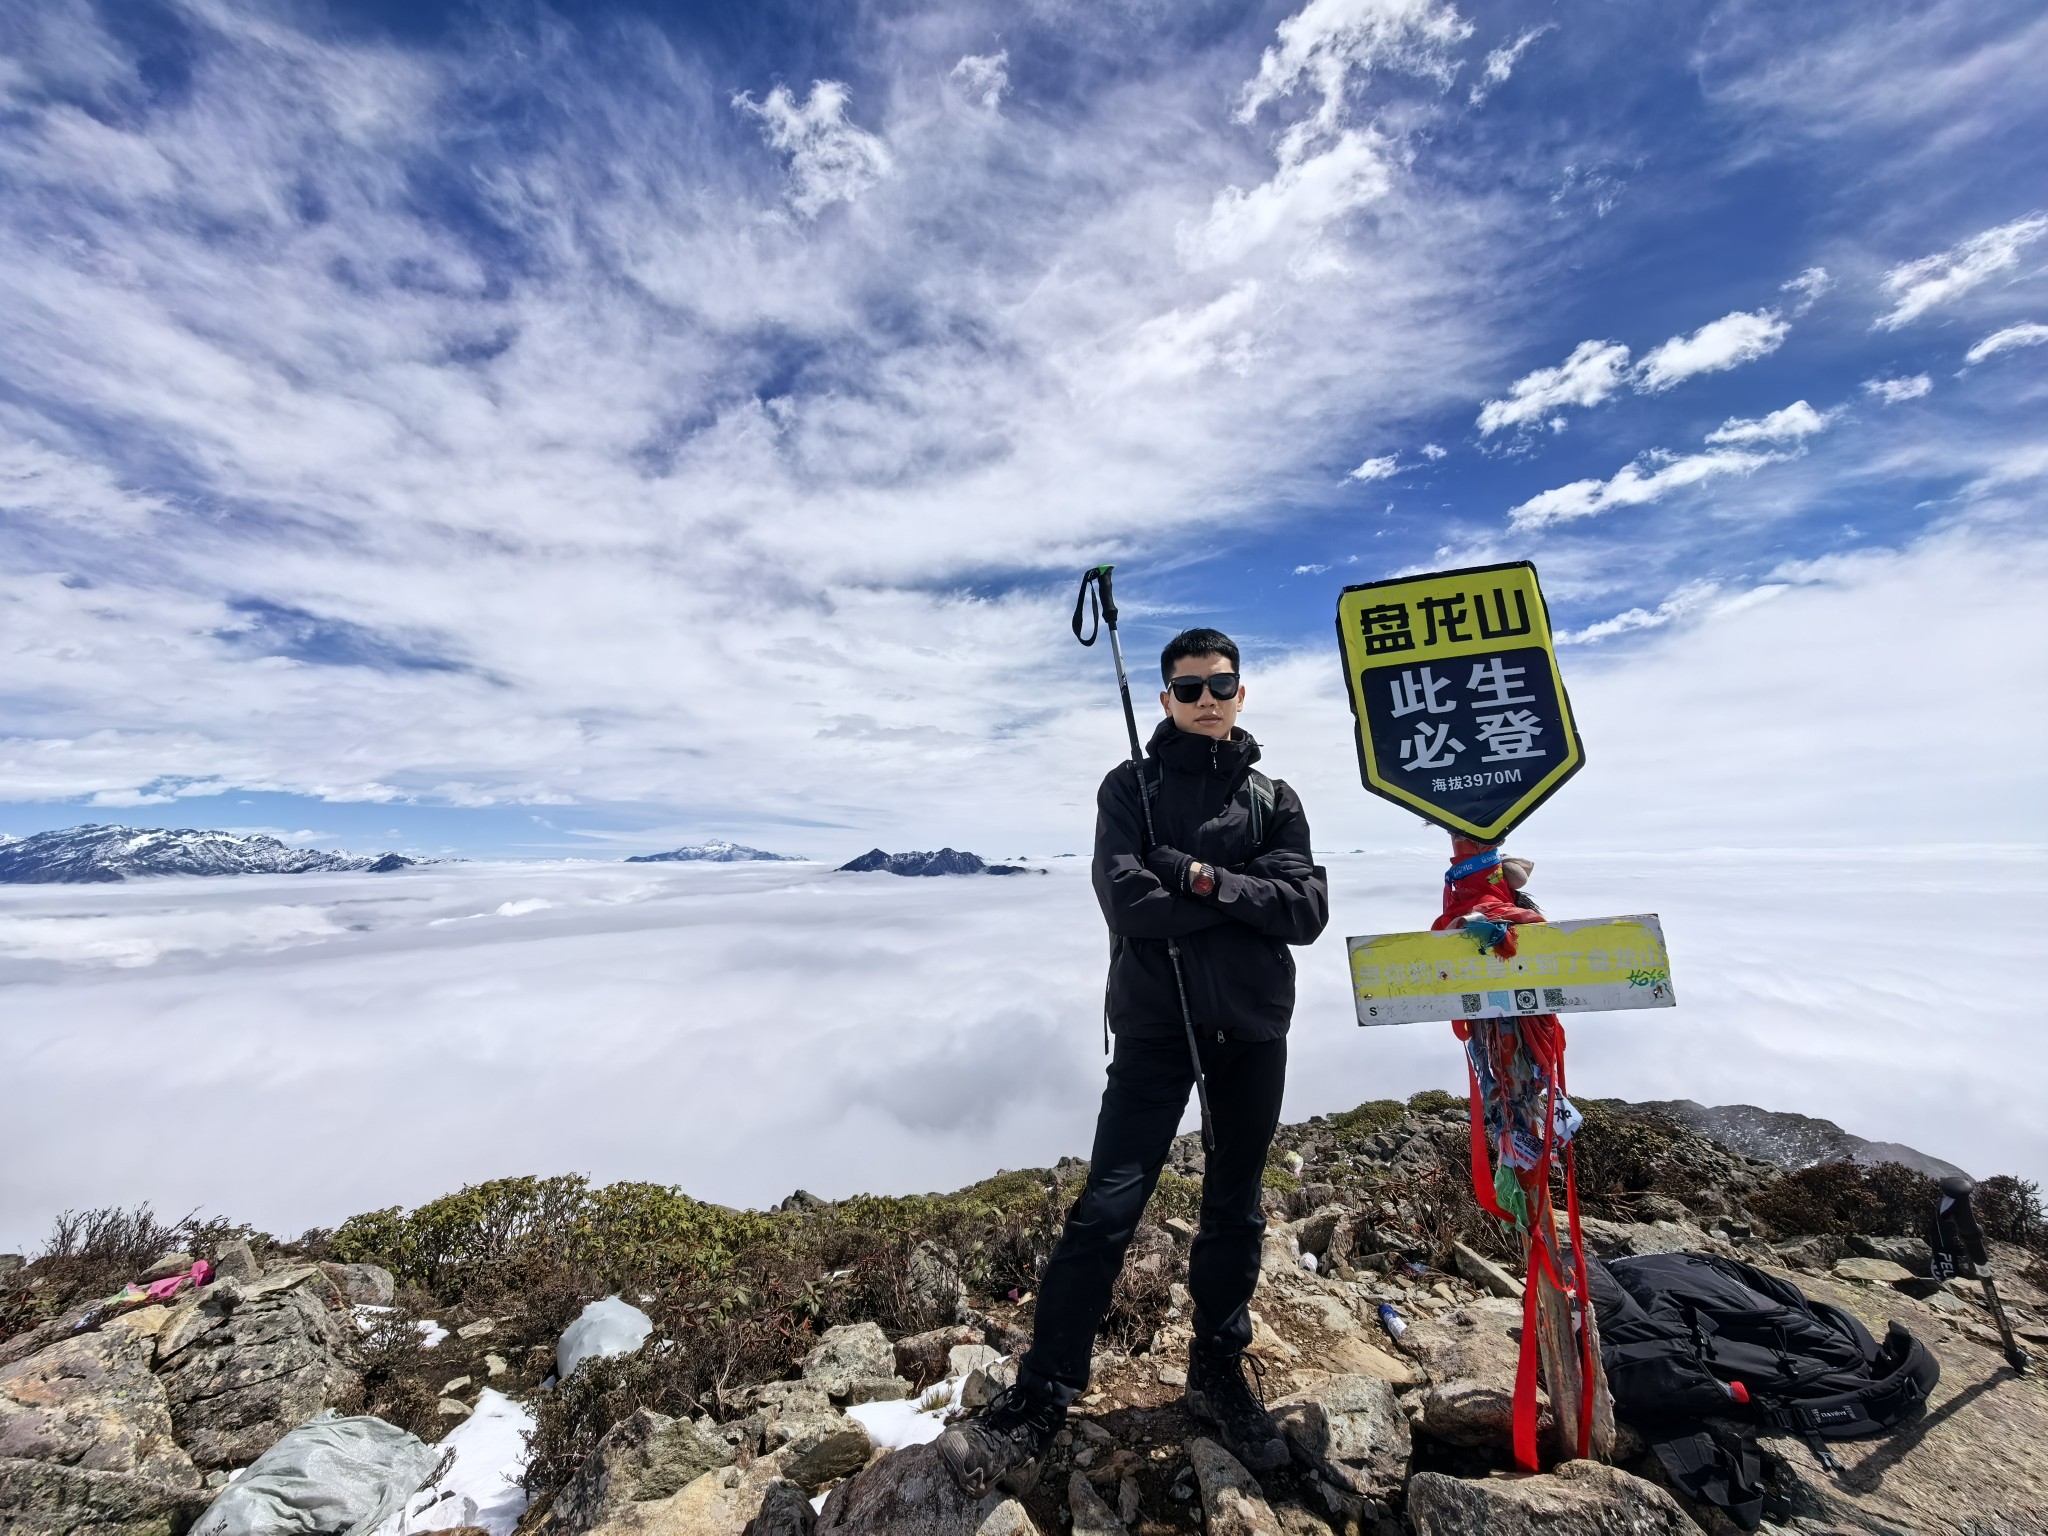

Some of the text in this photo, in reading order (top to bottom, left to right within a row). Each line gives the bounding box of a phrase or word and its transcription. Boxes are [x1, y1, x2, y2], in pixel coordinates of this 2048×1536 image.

[1360, 588, 1531, 656] 盘龙山
[1389, 657, 1536, 719] 此生
[1399, 708, 1547, 772] 必登
[1431, 768, 1522, 793] 海拔3970M
